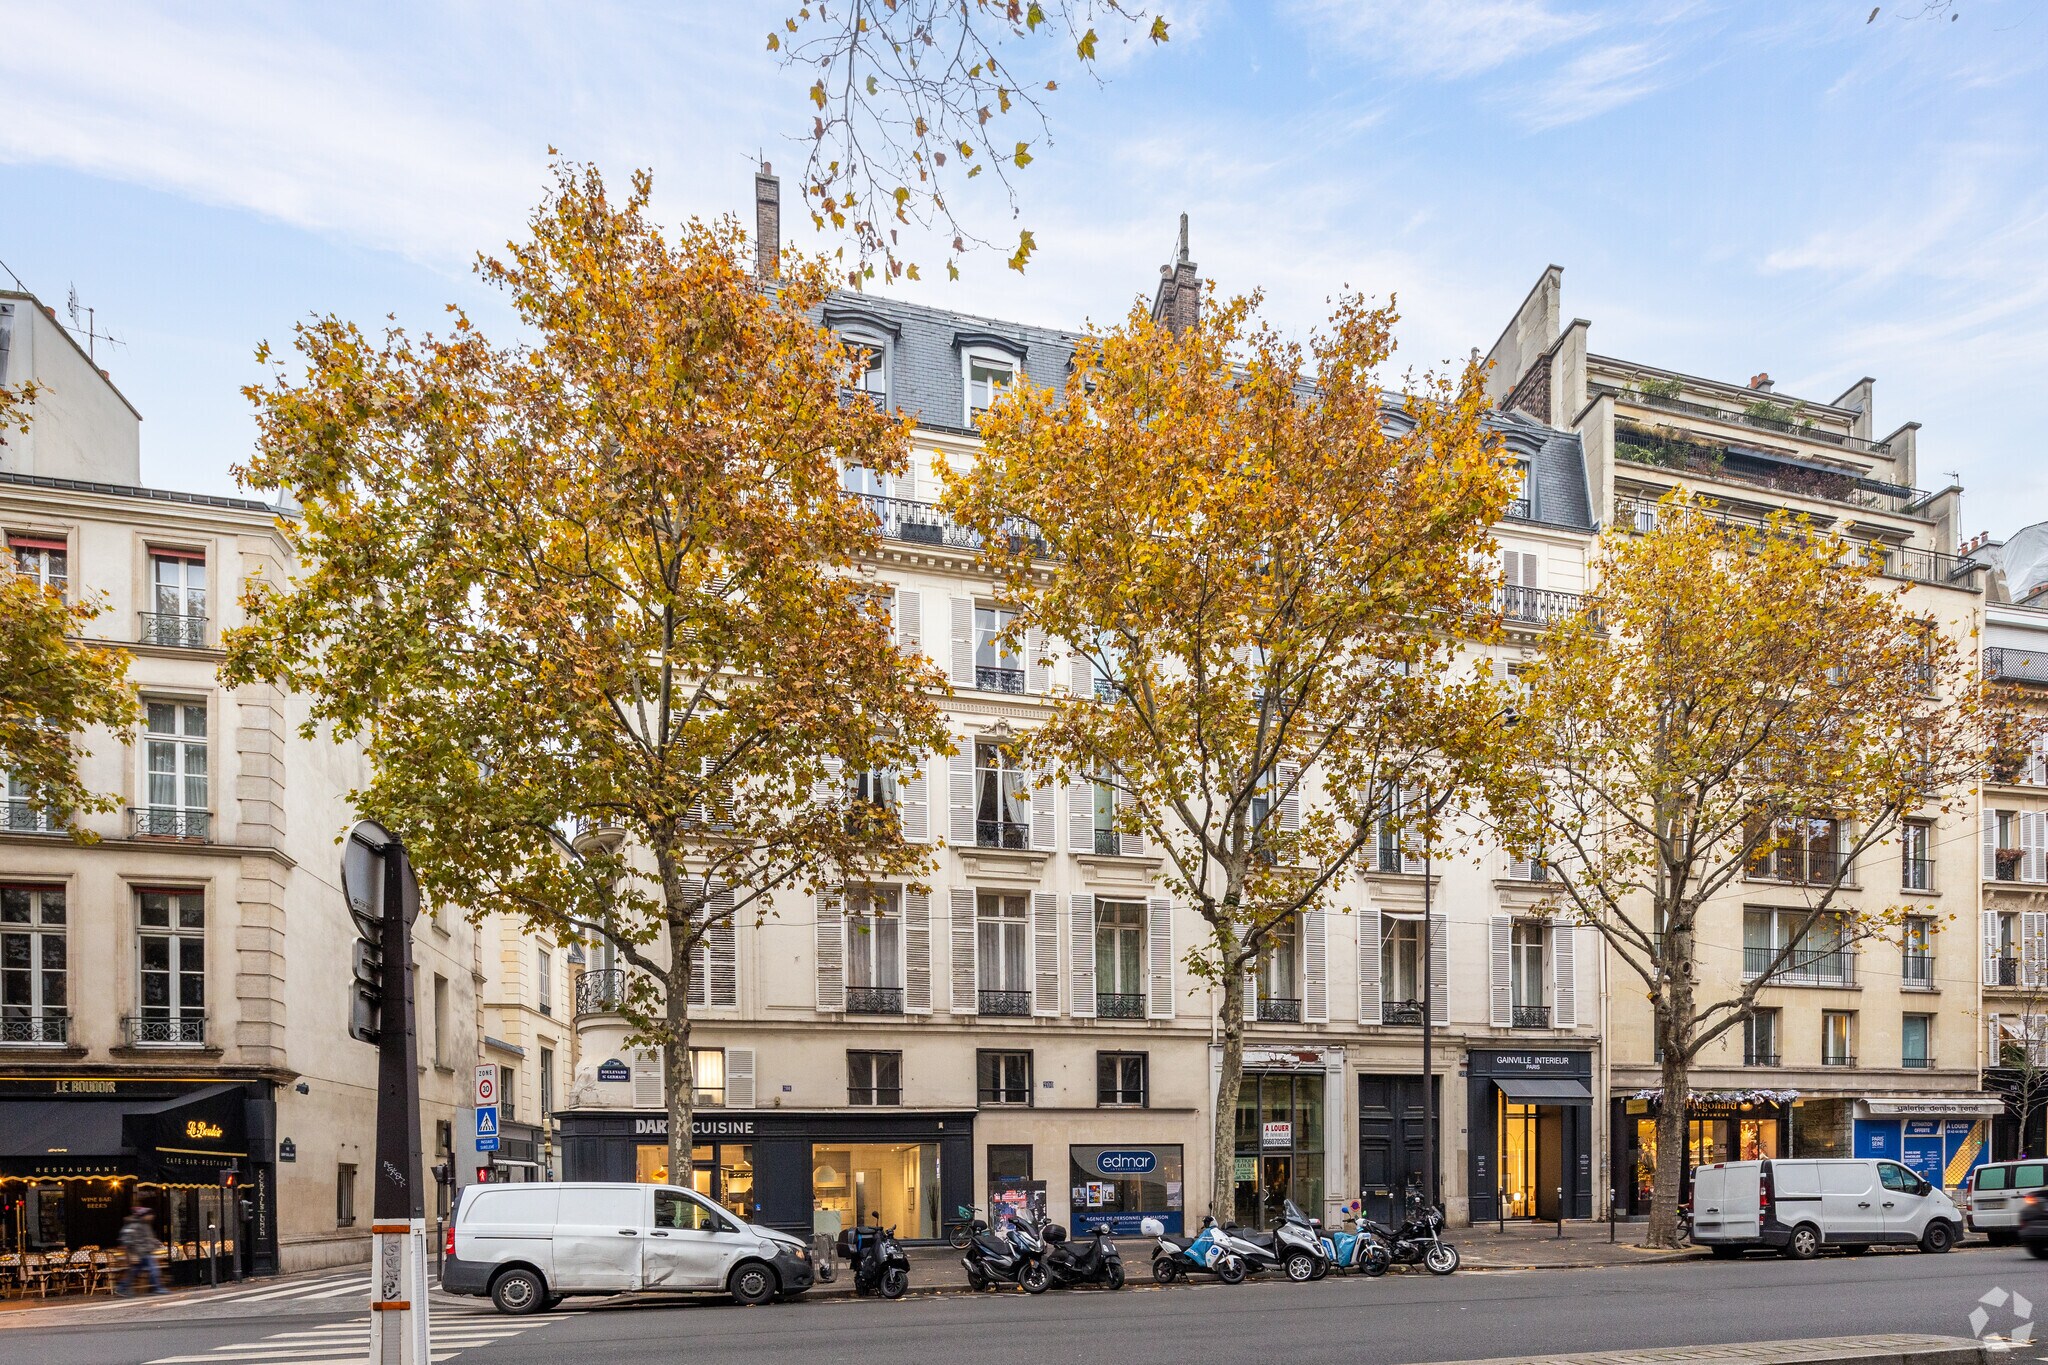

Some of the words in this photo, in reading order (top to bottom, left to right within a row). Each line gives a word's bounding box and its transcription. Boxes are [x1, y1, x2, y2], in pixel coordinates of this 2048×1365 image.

[1497, 1056, 1532, 1064] GAINVILLE
[1534, 1056, 1569, 1065] INTERIEUR
[479, 1069, 493, 1077] ZONE
[55, 1080, 68, 1093] LE
[72, 1080, 116, 1093] BOUDOIR
[482, 1085, 490, 1093] 30
[1897, 1104, 1925, 1113] galerie
[1929, 1104, 1957, 1112] denise
[635, 1119, 670, 1134] DAR
[691, 1122, 755, 1134] CUISINE
[1265, 1124, 1270, 1132] A
[1271, 1124, 1289, 1132] LOUER
[1102, 1153, 1151, 1168] edmar
